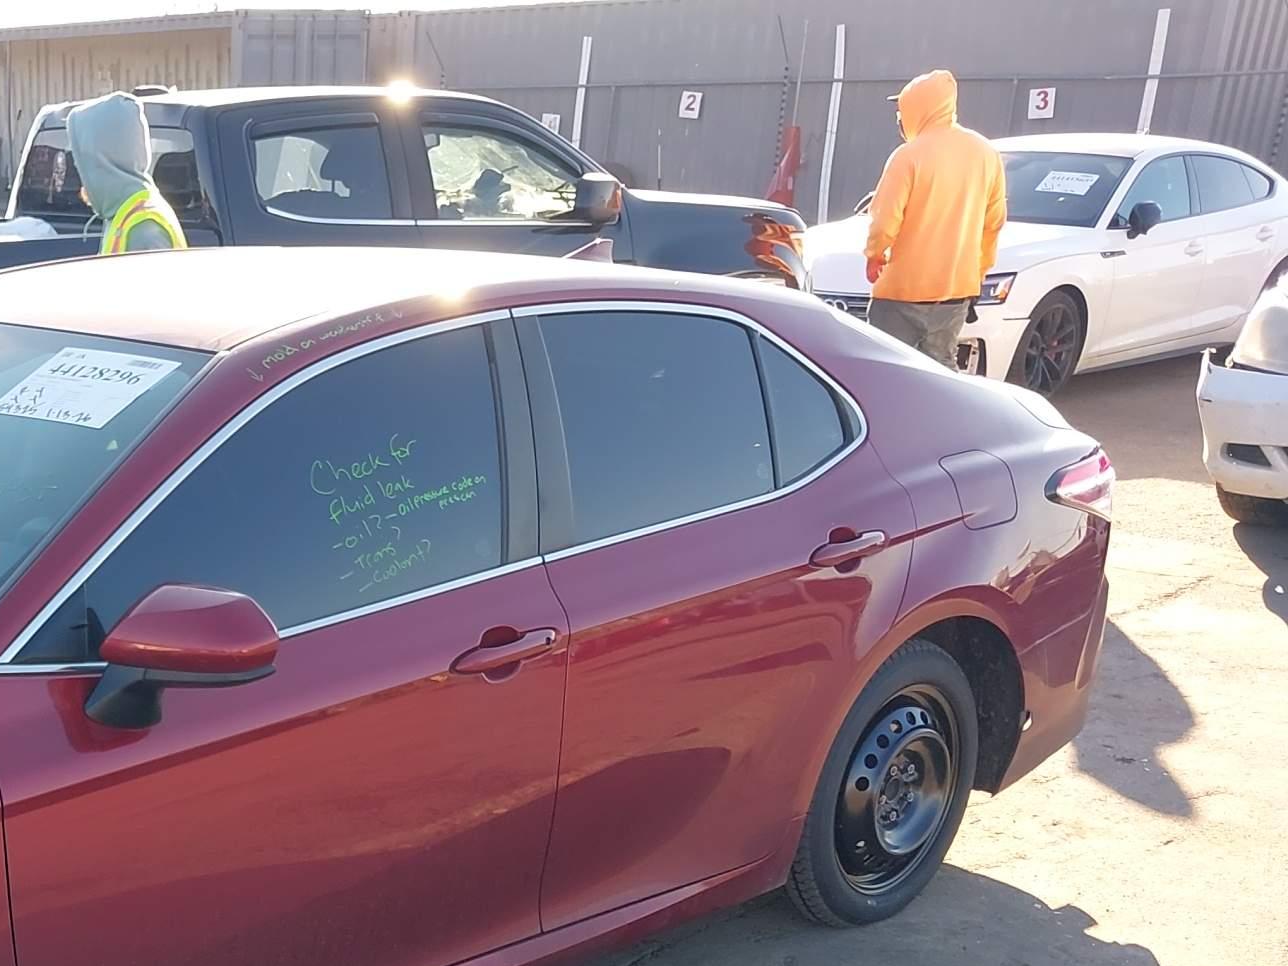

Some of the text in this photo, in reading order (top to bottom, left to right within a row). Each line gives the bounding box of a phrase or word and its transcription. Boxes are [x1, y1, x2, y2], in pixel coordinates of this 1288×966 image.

[684, 94, 697, 112] 2
[1035, 90, 1049, 111] 3
[48, 362, 146, 386] 44128296
[310, 433, 417, 495] Check for
[376, 475, 416, 500] leak
